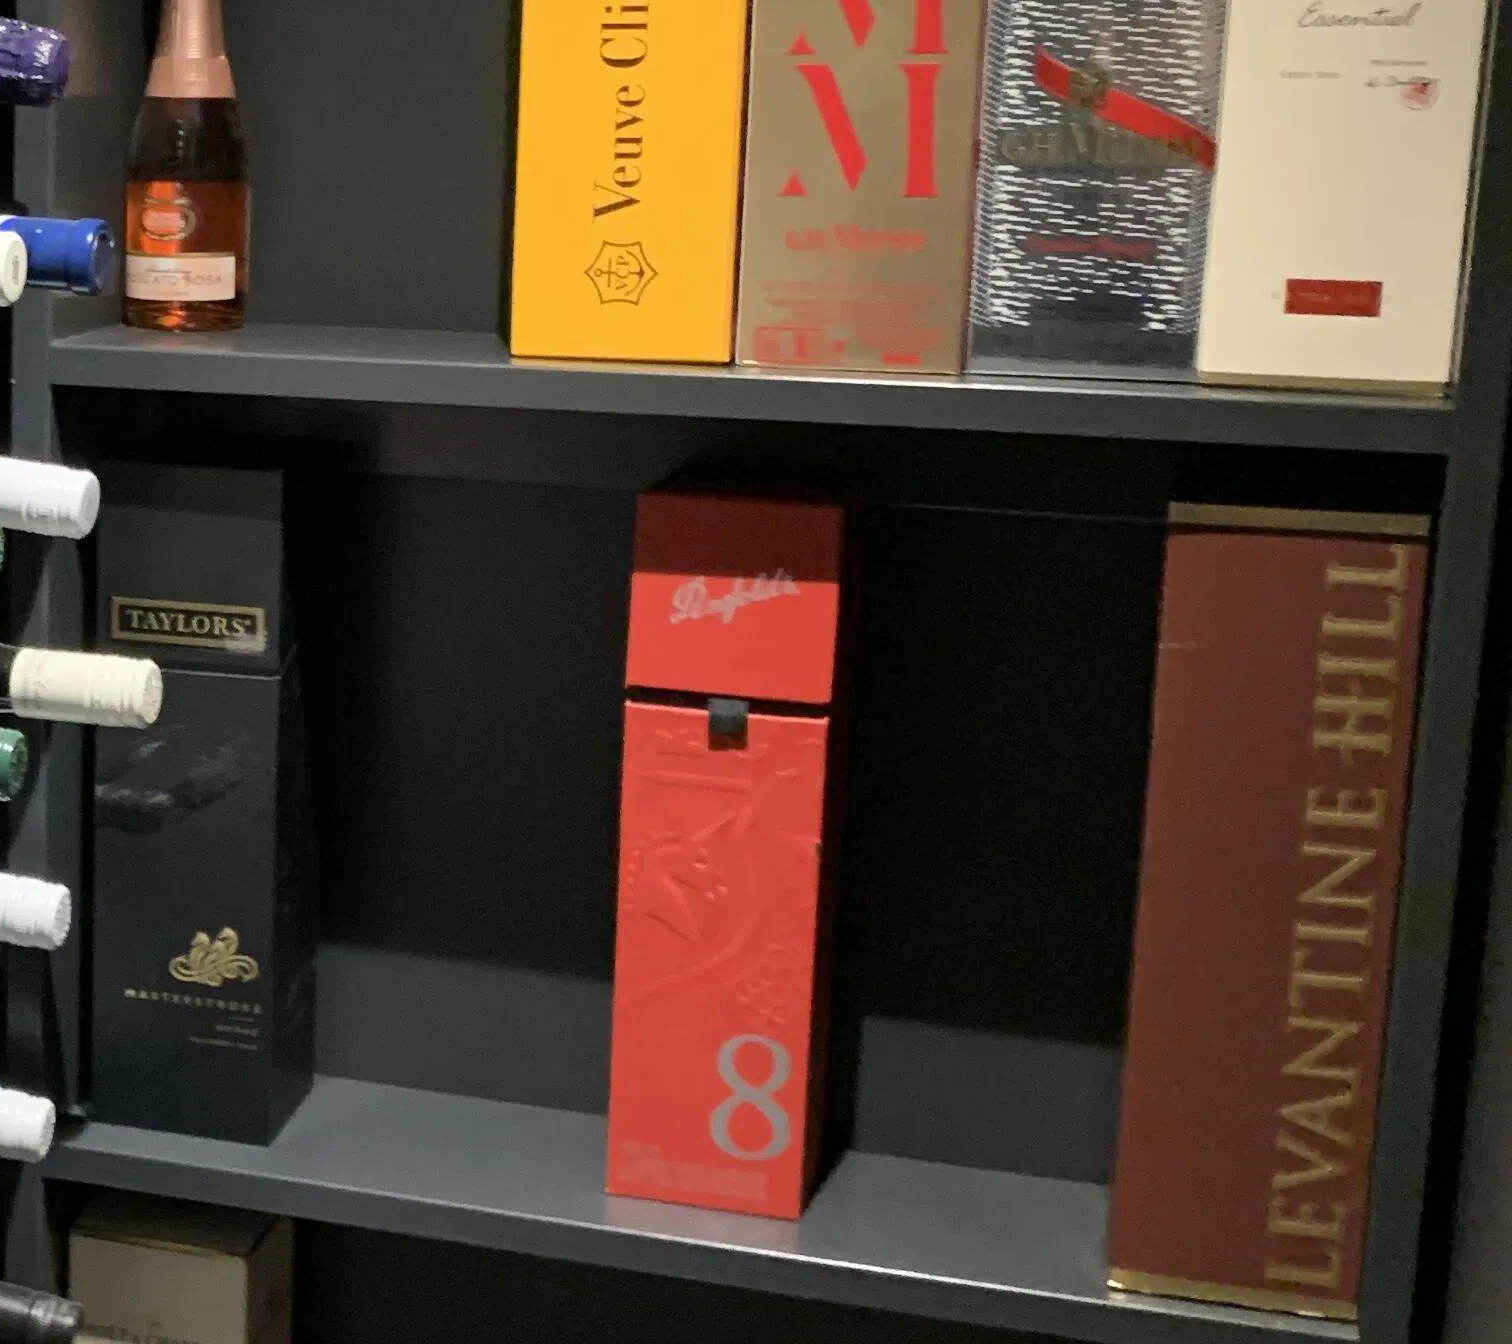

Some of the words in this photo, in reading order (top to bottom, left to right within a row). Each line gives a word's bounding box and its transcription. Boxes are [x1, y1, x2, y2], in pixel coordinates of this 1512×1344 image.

[592, 84, 646, 224] Veuve
[1313, 542, 1410, 763] HILL
[709, 1032, 793, 1161] 8
[1264, 785, 1390, 1290] LEVANTINE
